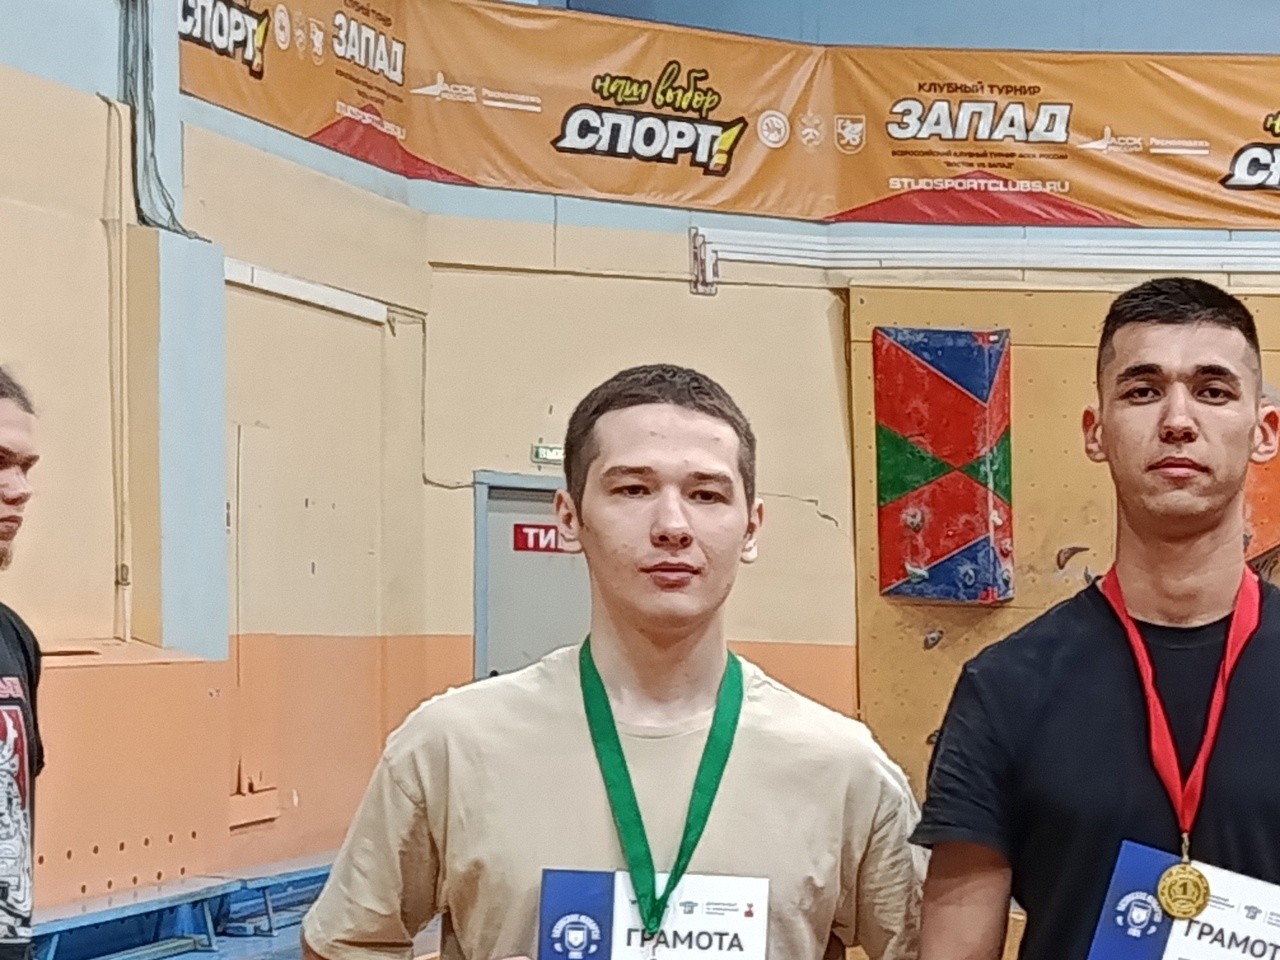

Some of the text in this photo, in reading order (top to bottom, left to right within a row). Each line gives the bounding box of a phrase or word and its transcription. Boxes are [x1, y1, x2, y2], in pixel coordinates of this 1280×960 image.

[331, 11, 406, 86] ЗАПАД
[594, 61, 720, 118] наш выбор
[918, 81, 1041, 96] КЛУБНЫЙ ТУРНИР
[887, 98, 1072, 143] ЗАПАД
[552, 105, 747, 174] СПОРТ!
[888, 177, 1070, 193] STUDSPORTCLUBS.RU
[522, 527, 562, 549] ТИ
[1179, 881, 1189, 896] 1
[626, 928, 744, 952] ГРАМОТА
